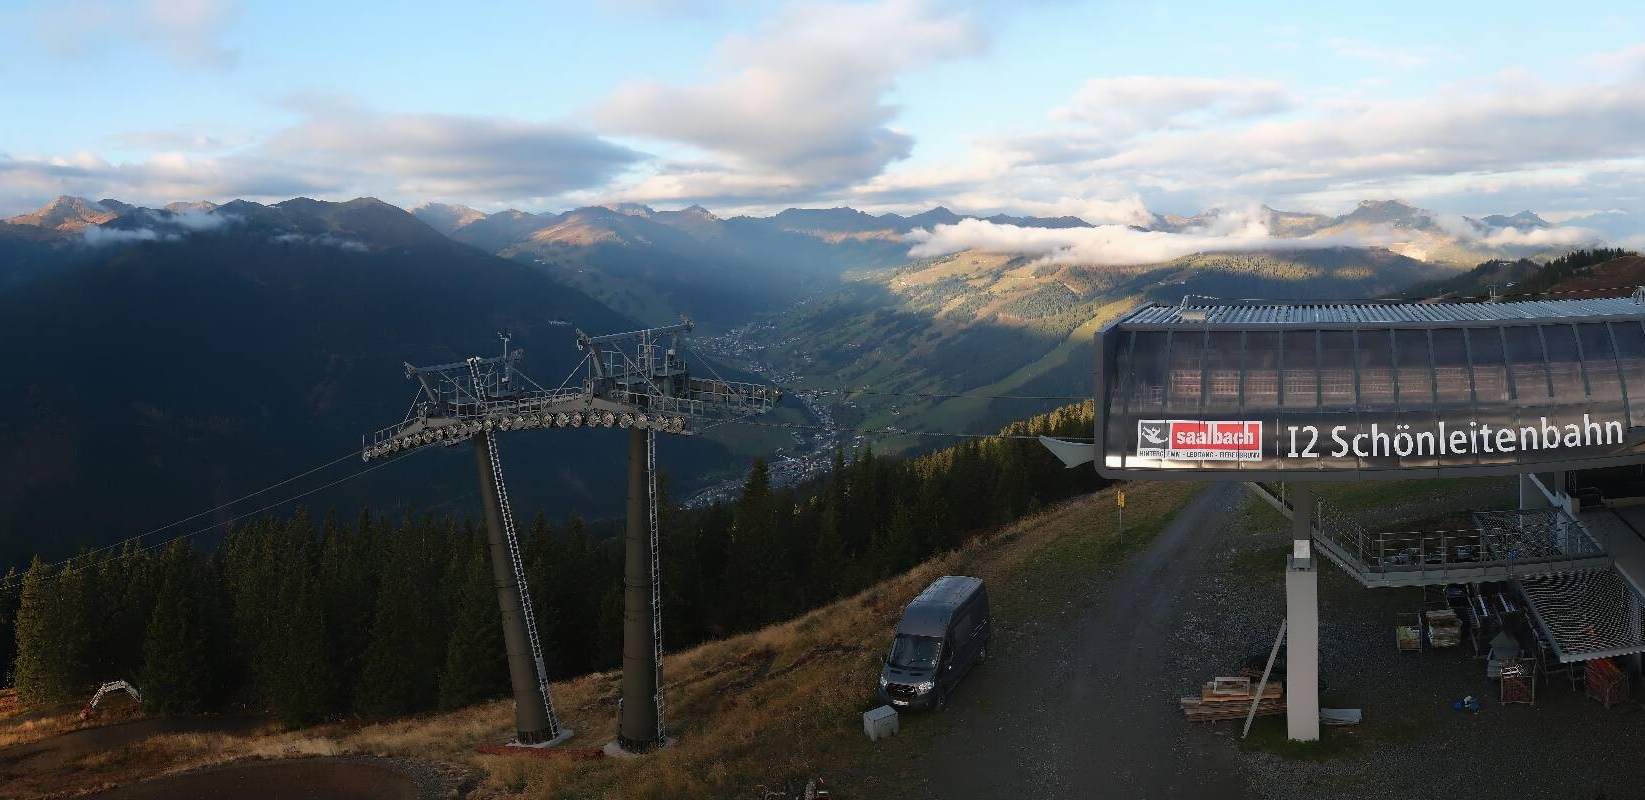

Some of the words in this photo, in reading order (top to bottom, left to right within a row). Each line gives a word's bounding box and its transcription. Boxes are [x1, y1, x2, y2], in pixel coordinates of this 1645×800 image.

[1176, 422, 1254, 445] saalbach
[1287, 425, 1320, 458] I2
[1331, 414, 1624, 458] Schönleitenbahn
